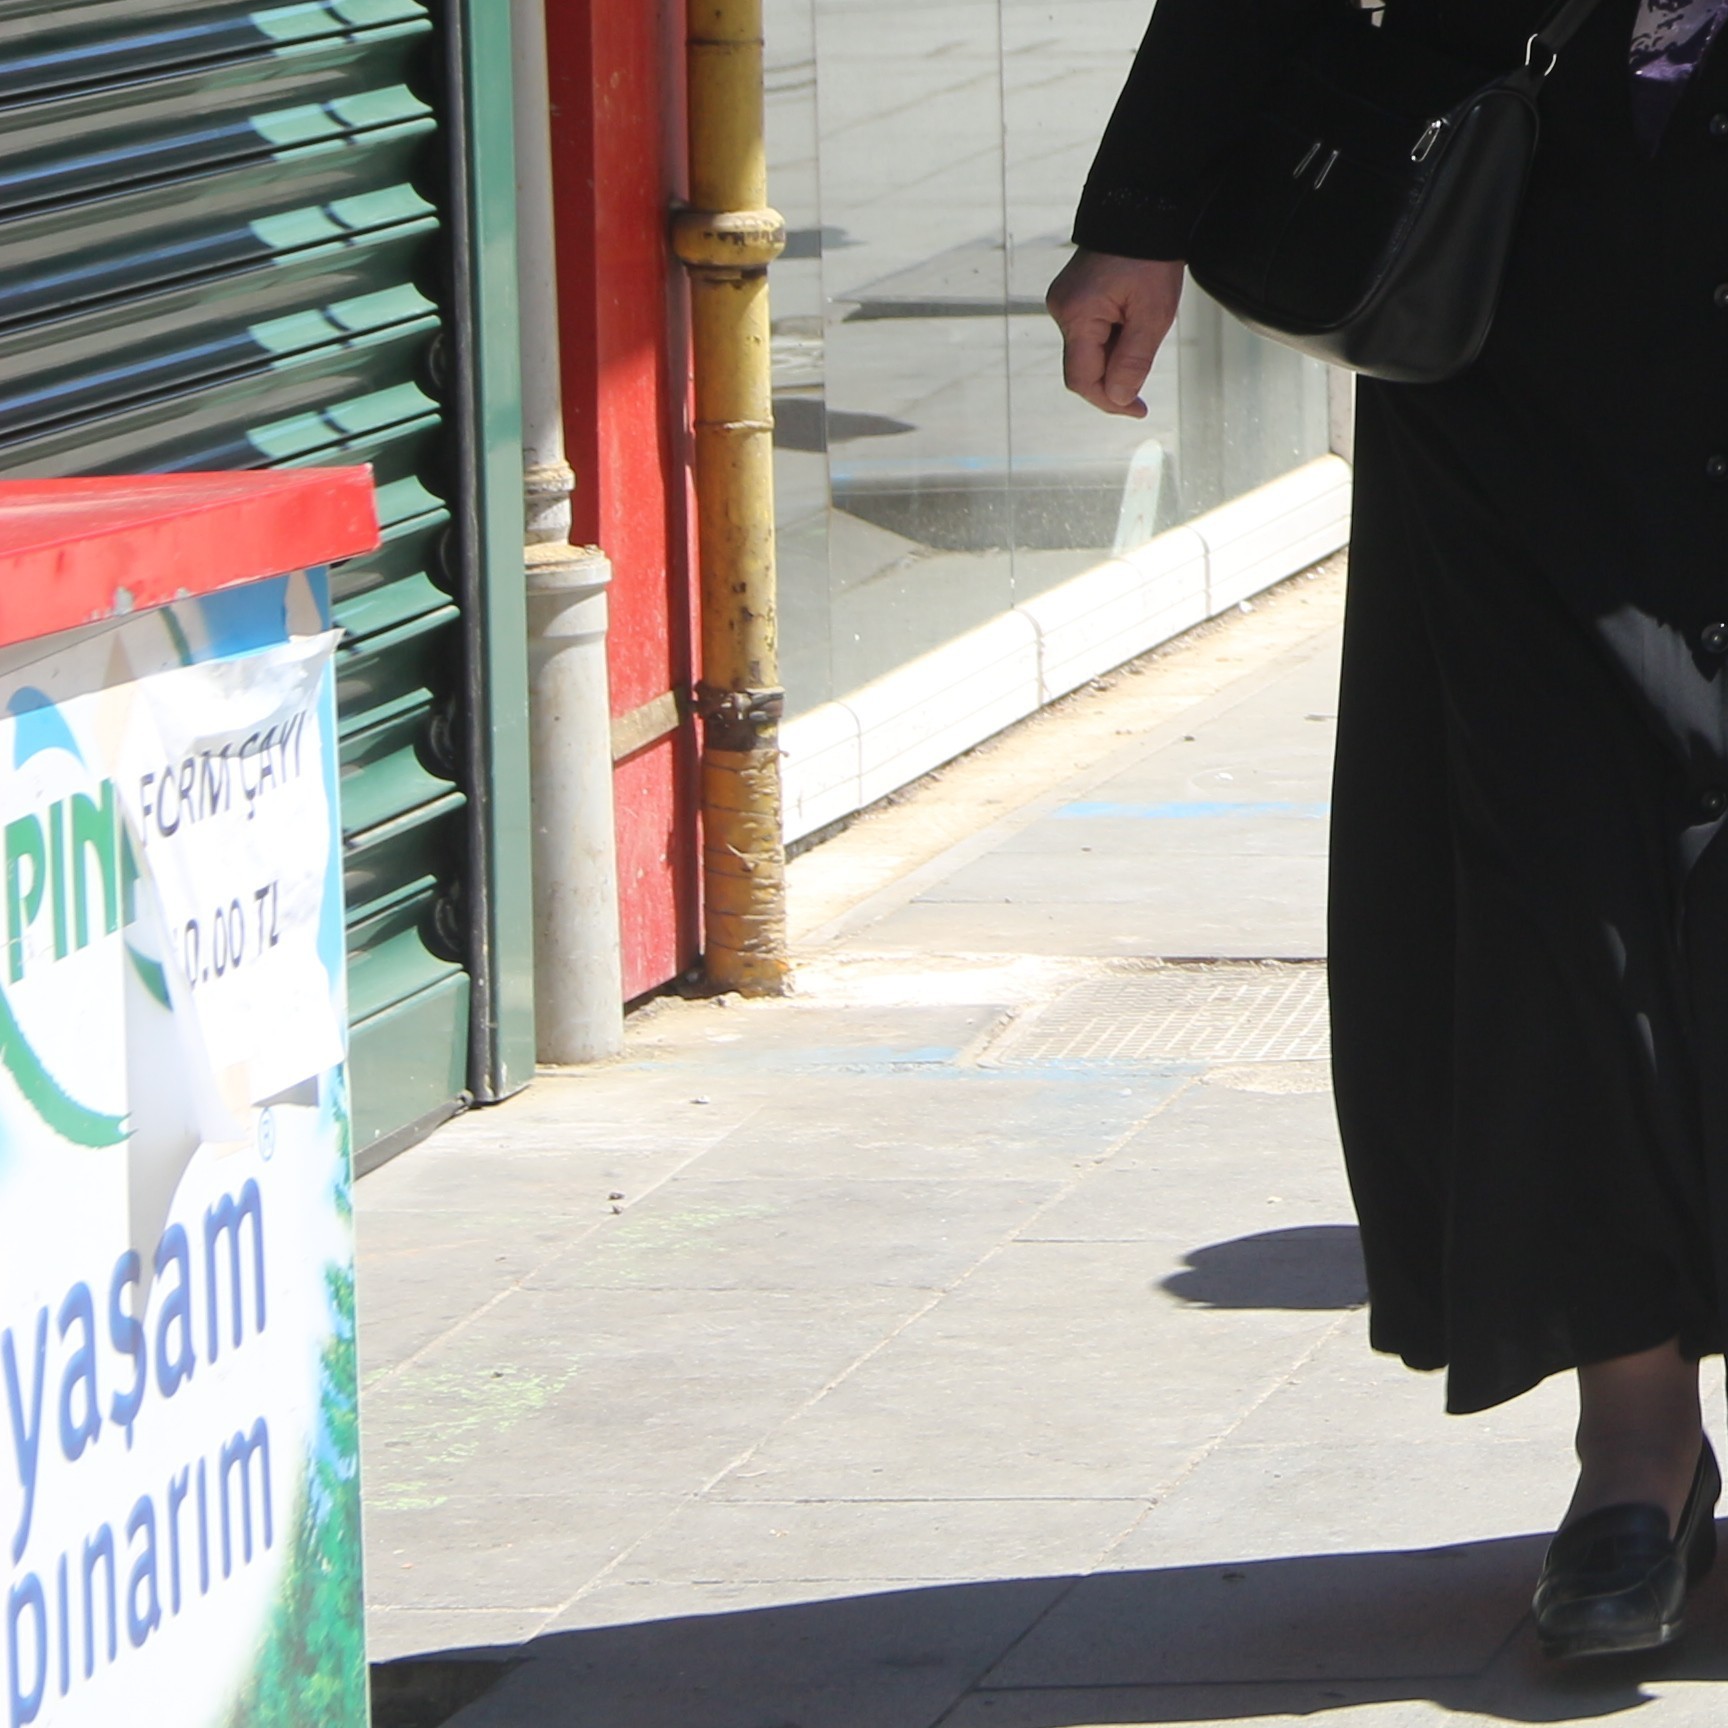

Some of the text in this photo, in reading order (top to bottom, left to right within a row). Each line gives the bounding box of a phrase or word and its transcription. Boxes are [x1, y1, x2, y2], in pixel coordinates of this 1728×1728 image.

[180, 878, 281, 992] 0.00 TL
[2, 1177, 267, 1566] yaşam
[7, 1416, 273, 1728] pınarım
